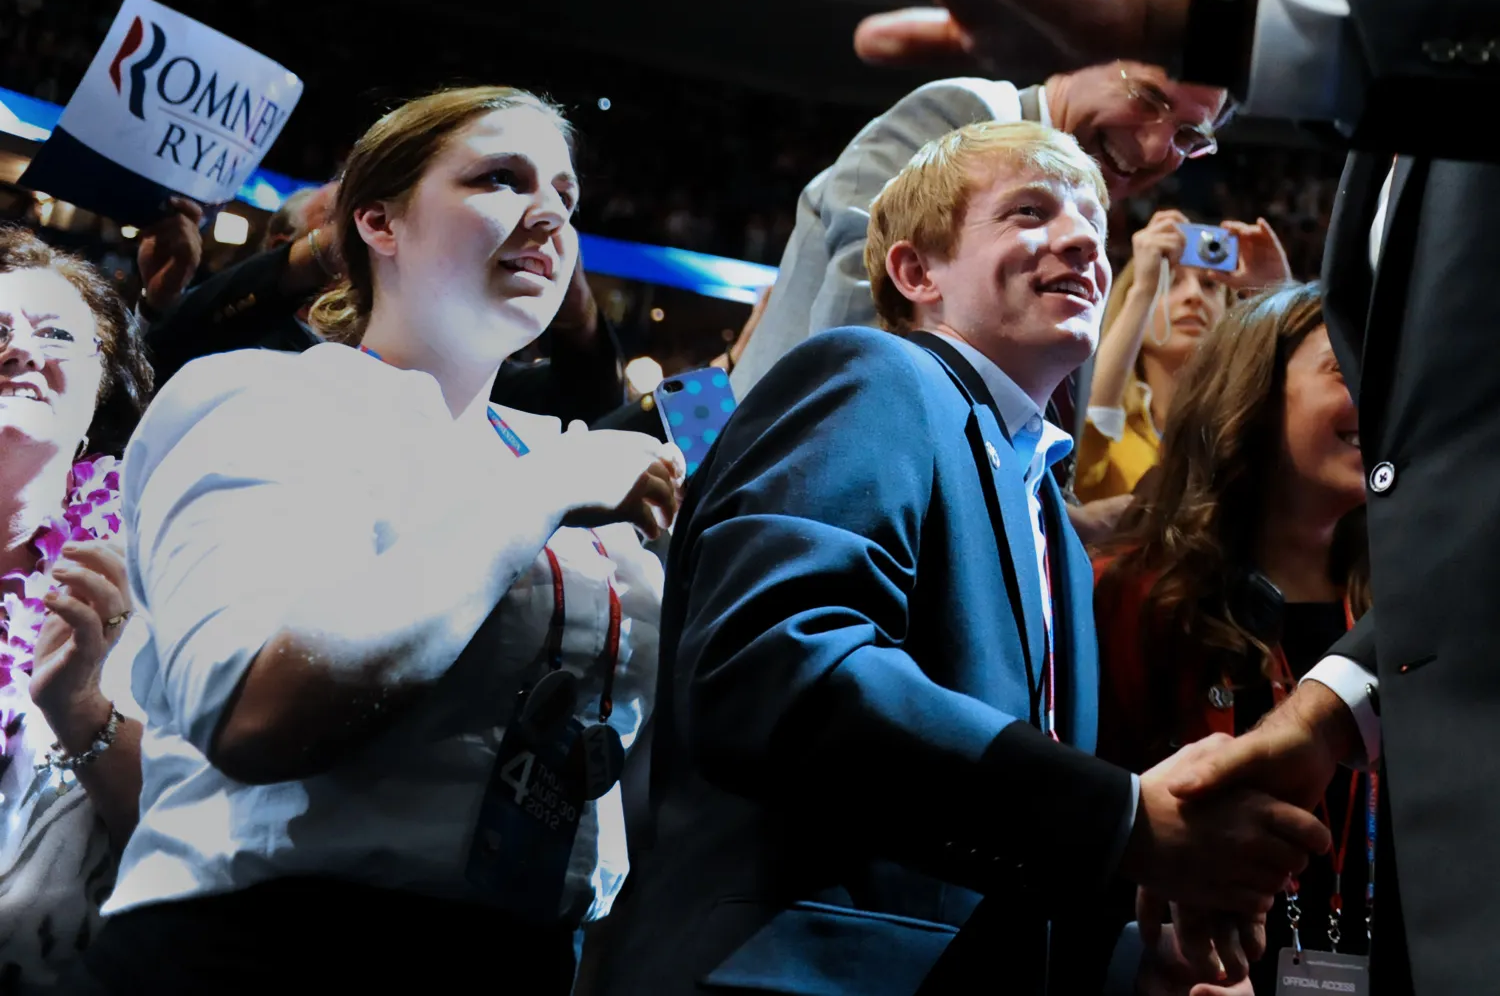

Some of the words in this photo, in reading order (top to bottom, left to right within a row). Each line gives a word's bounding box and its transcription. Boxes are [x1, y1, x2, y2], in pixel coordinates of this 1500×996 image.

[109, 15, 287, 148] ROMNEY
[499, 749, 537, 806] 4
[525, 797, 560, 832] 2012
[530, 780, 558, 809] AUG
[558, 800, 576, 822] 30
[1282, 976, 1320, 989] OFFICIAL
[1321, 980, 1356, 993] ACCESS
